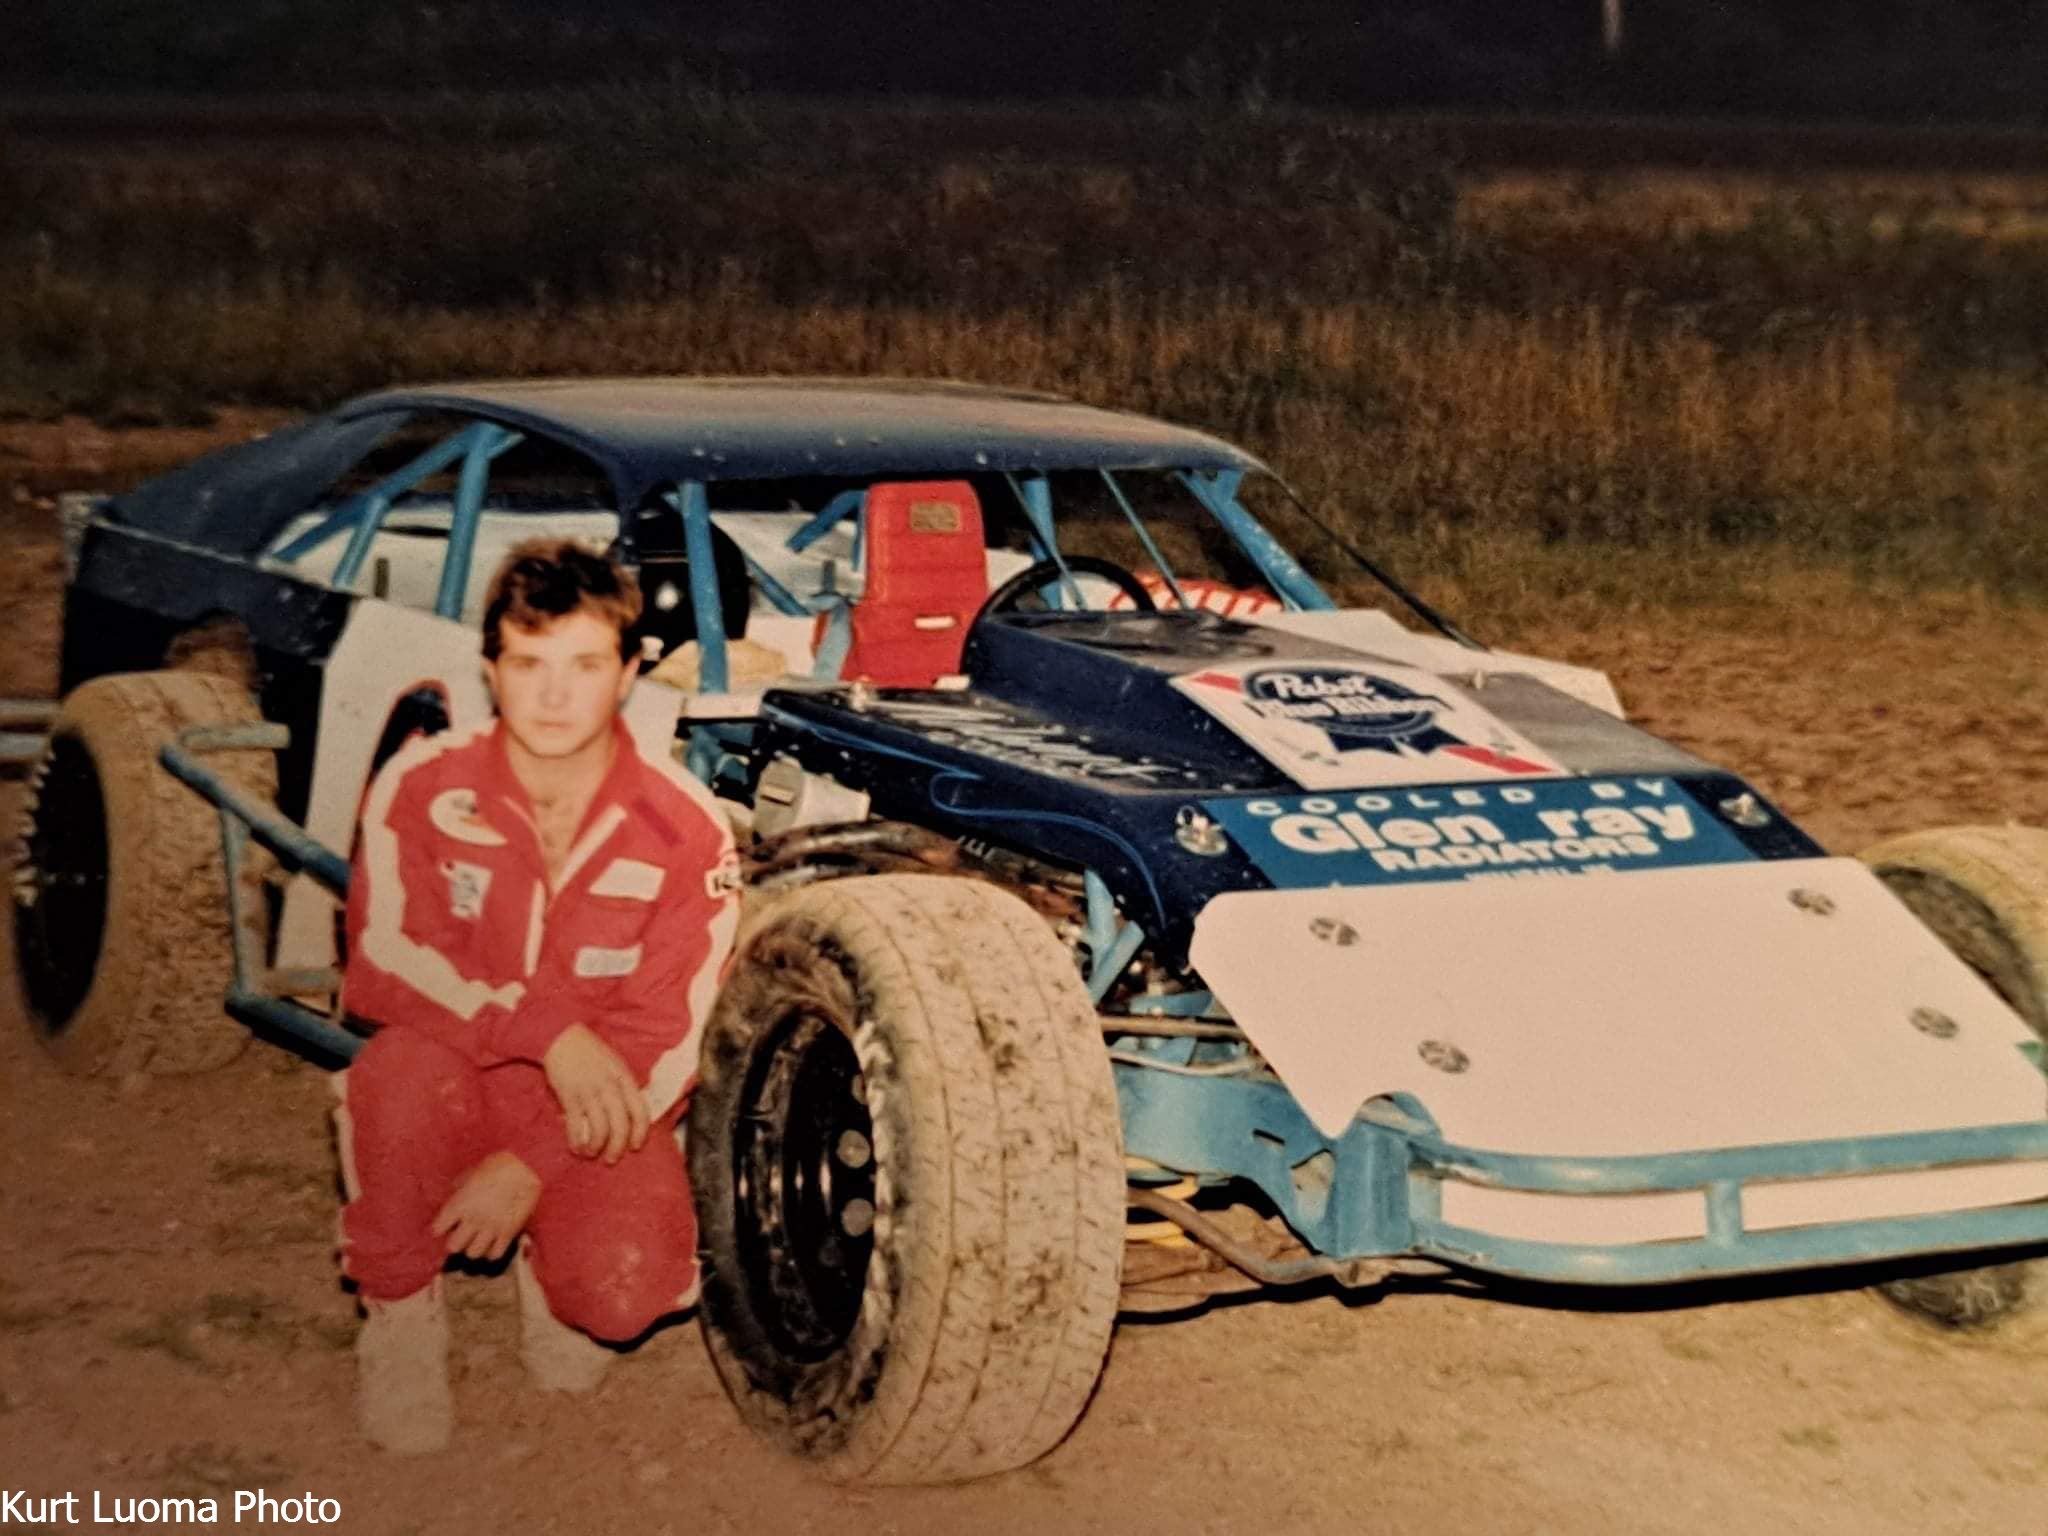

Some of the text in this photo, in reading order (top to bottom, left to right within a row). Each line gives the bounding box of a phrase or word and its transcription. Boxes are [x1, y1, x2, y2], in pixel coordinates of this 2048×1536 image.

[1246, 777, 1665, 816] COOLED BY
[1271, 804, 1694, 853] Glen ray
[1370, 835, 1660, 872] RADIATORS
